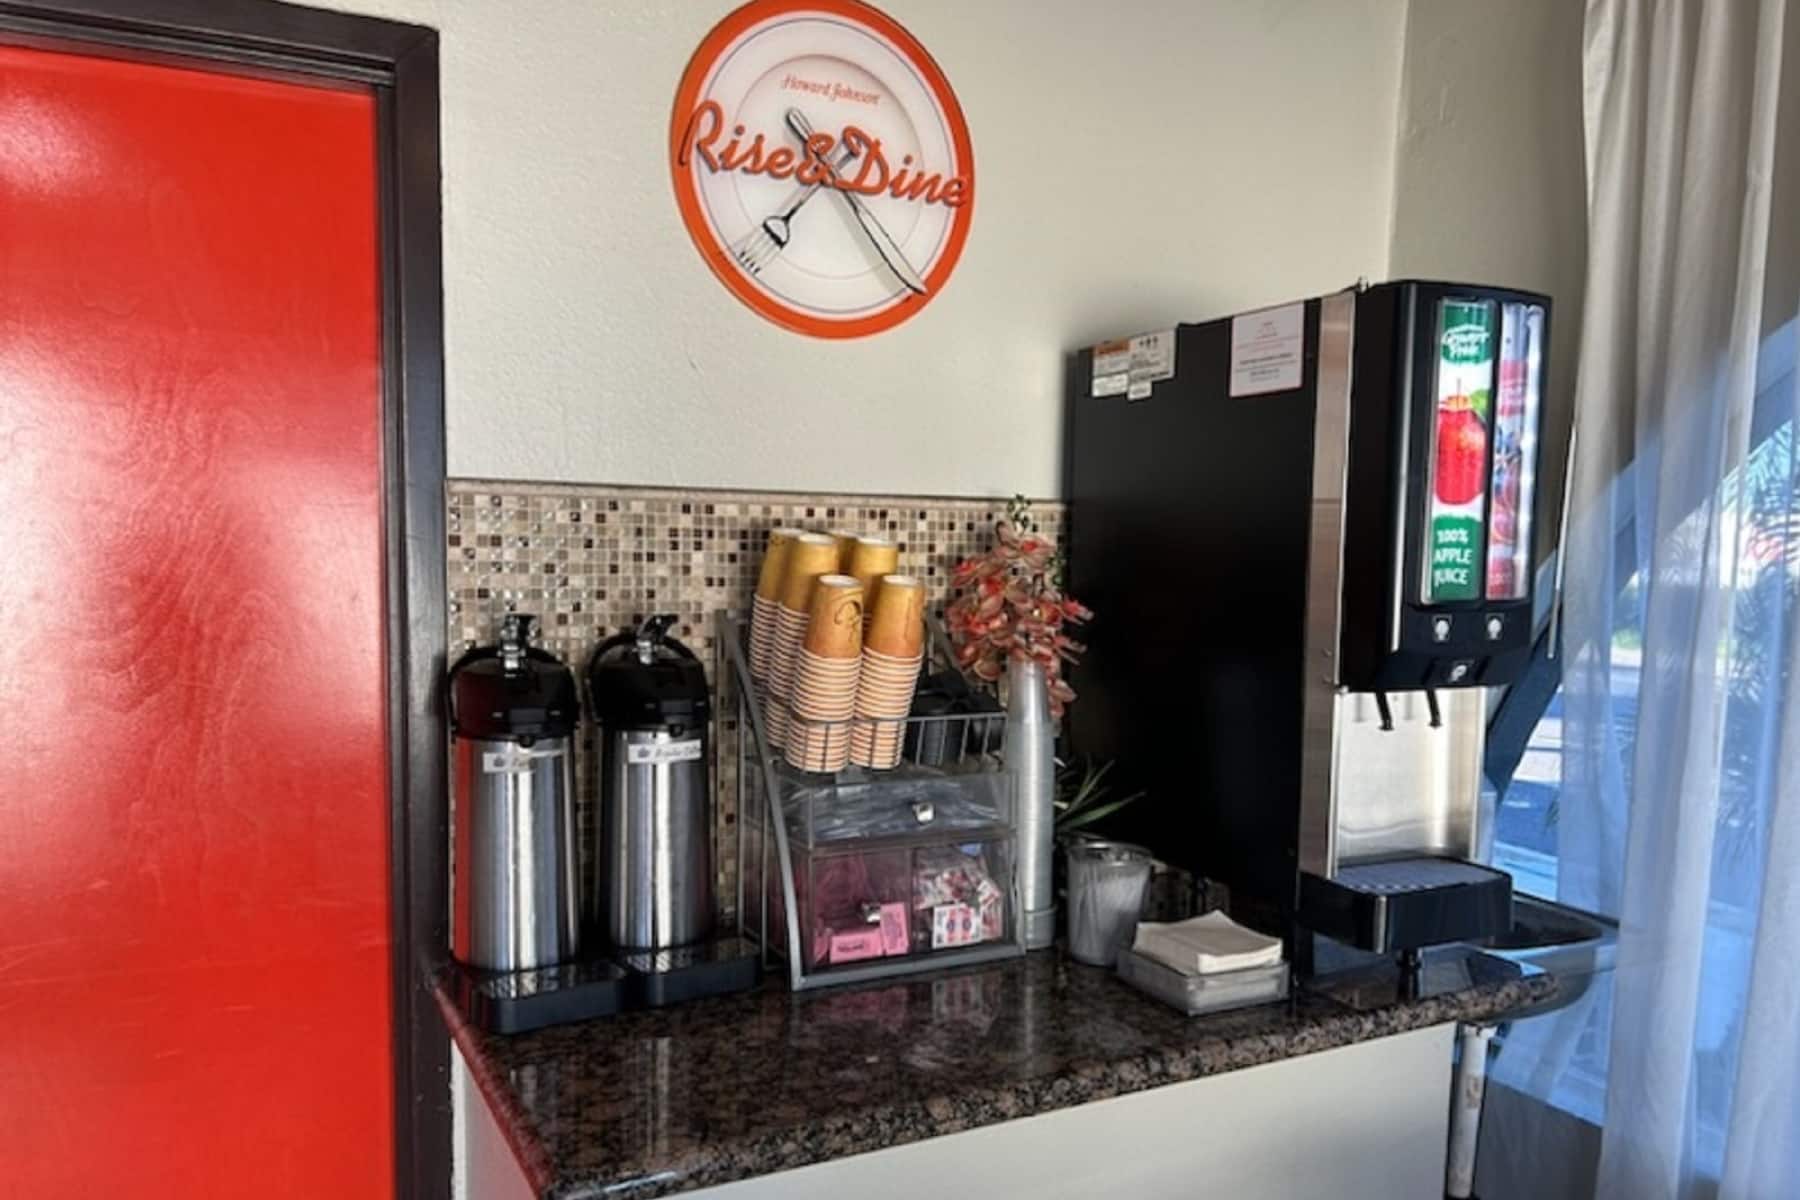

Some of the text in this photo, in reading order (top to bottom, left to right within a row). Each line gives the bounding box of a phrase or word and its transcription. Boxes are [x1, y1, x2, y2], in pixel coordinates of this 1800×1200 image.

[782, 73, 831, 96] Howard
[1437, 528, 1469, 543] 100%
[1434, 548, 1472, 565] APPLE
[1433, 568, 1469, 587] JUICE
